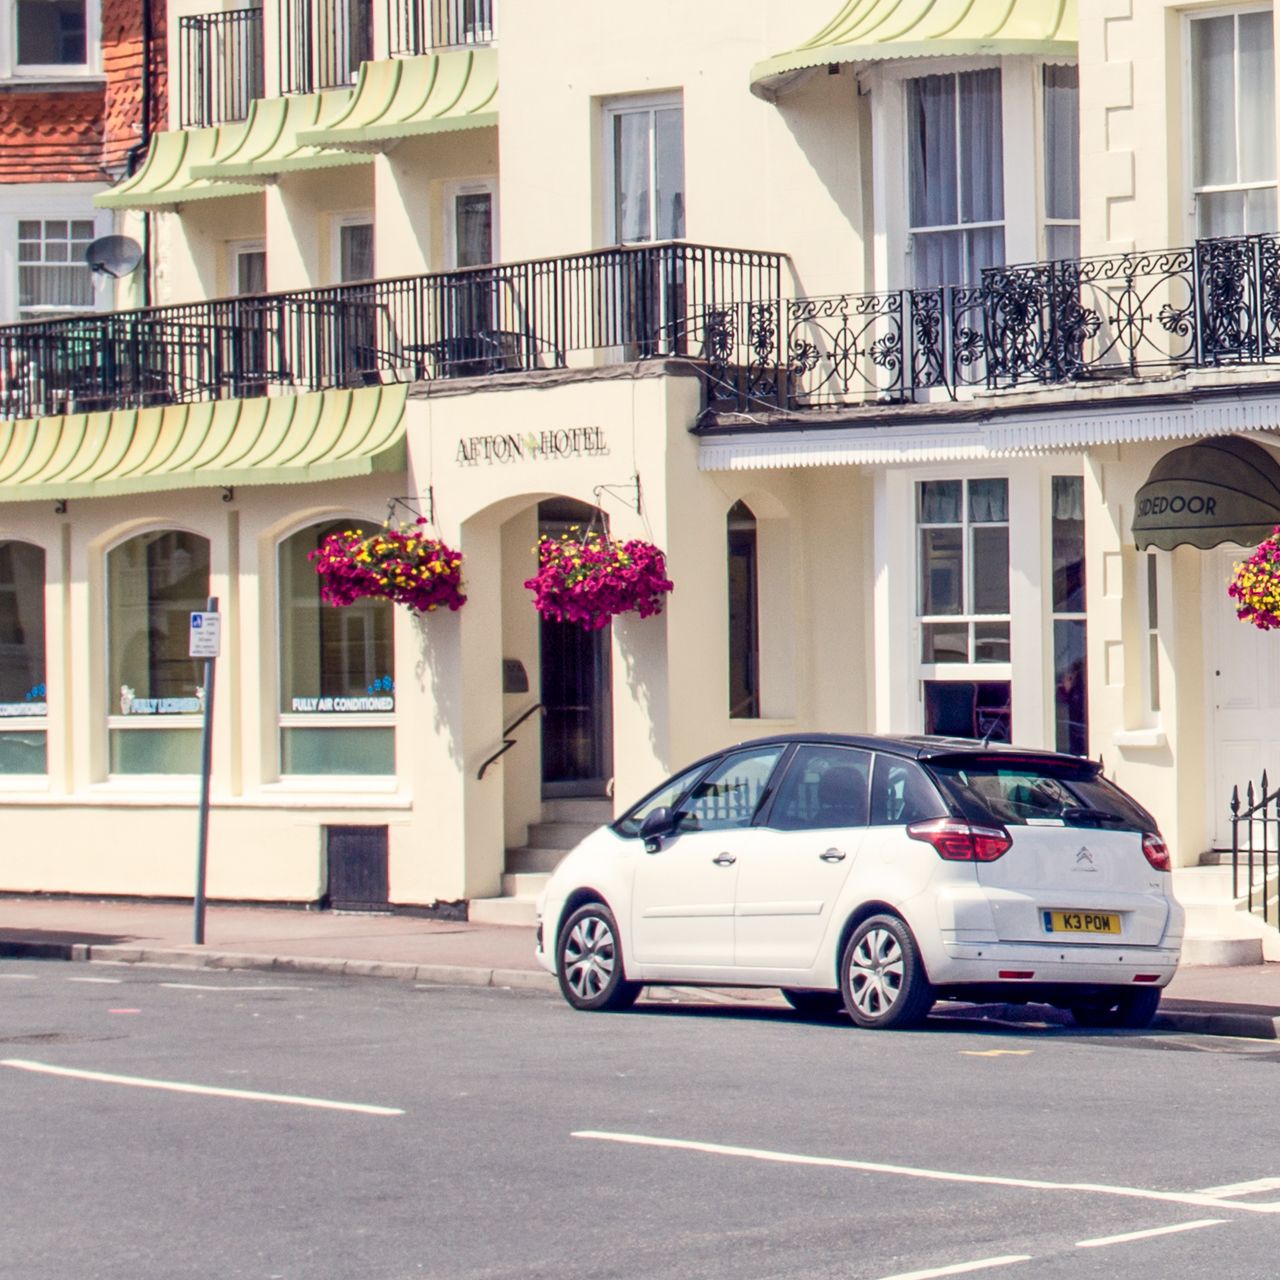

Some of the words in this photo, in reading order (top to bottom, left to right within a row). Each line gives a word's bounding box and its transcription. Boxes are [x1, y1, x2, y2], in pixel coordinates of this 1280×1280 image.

[456, 433, 522, 463] AFTON
[538, 426, 608, 454] HOTEL
[1138, 496, 1217, 518] SIDEDOOR
[292, 698, 318, 711] FULLY
[318, 698, 333, 711] AIR
[334, 697, 393, 711] CONDITIONED
[1063, 914, 1081, 929] K3
[1085, 915, 1111, 931] POM
